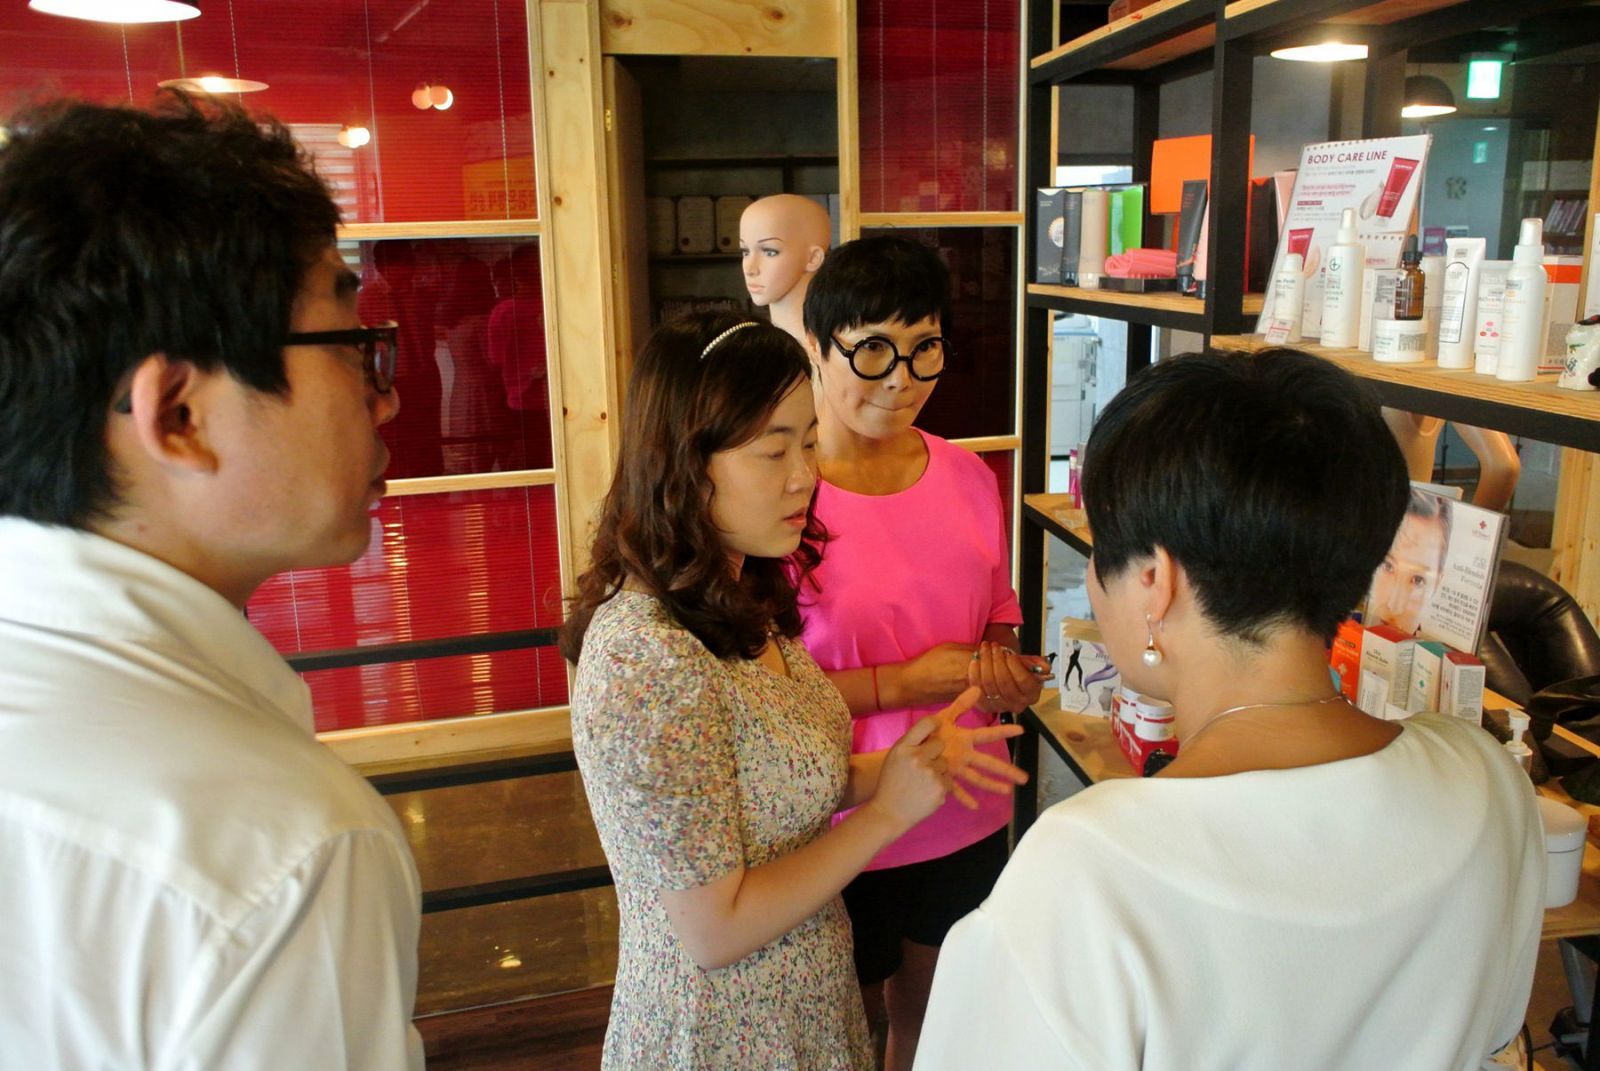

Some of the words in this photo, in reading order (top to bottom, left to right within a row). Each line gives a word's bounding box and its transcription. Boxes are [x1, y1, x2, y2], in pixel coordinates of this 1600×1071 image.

[1307, 153, 1335, 165] BODY
[1337, 151, 1364, 163] CARE
[1366, 150, 1388, 162] LINE
